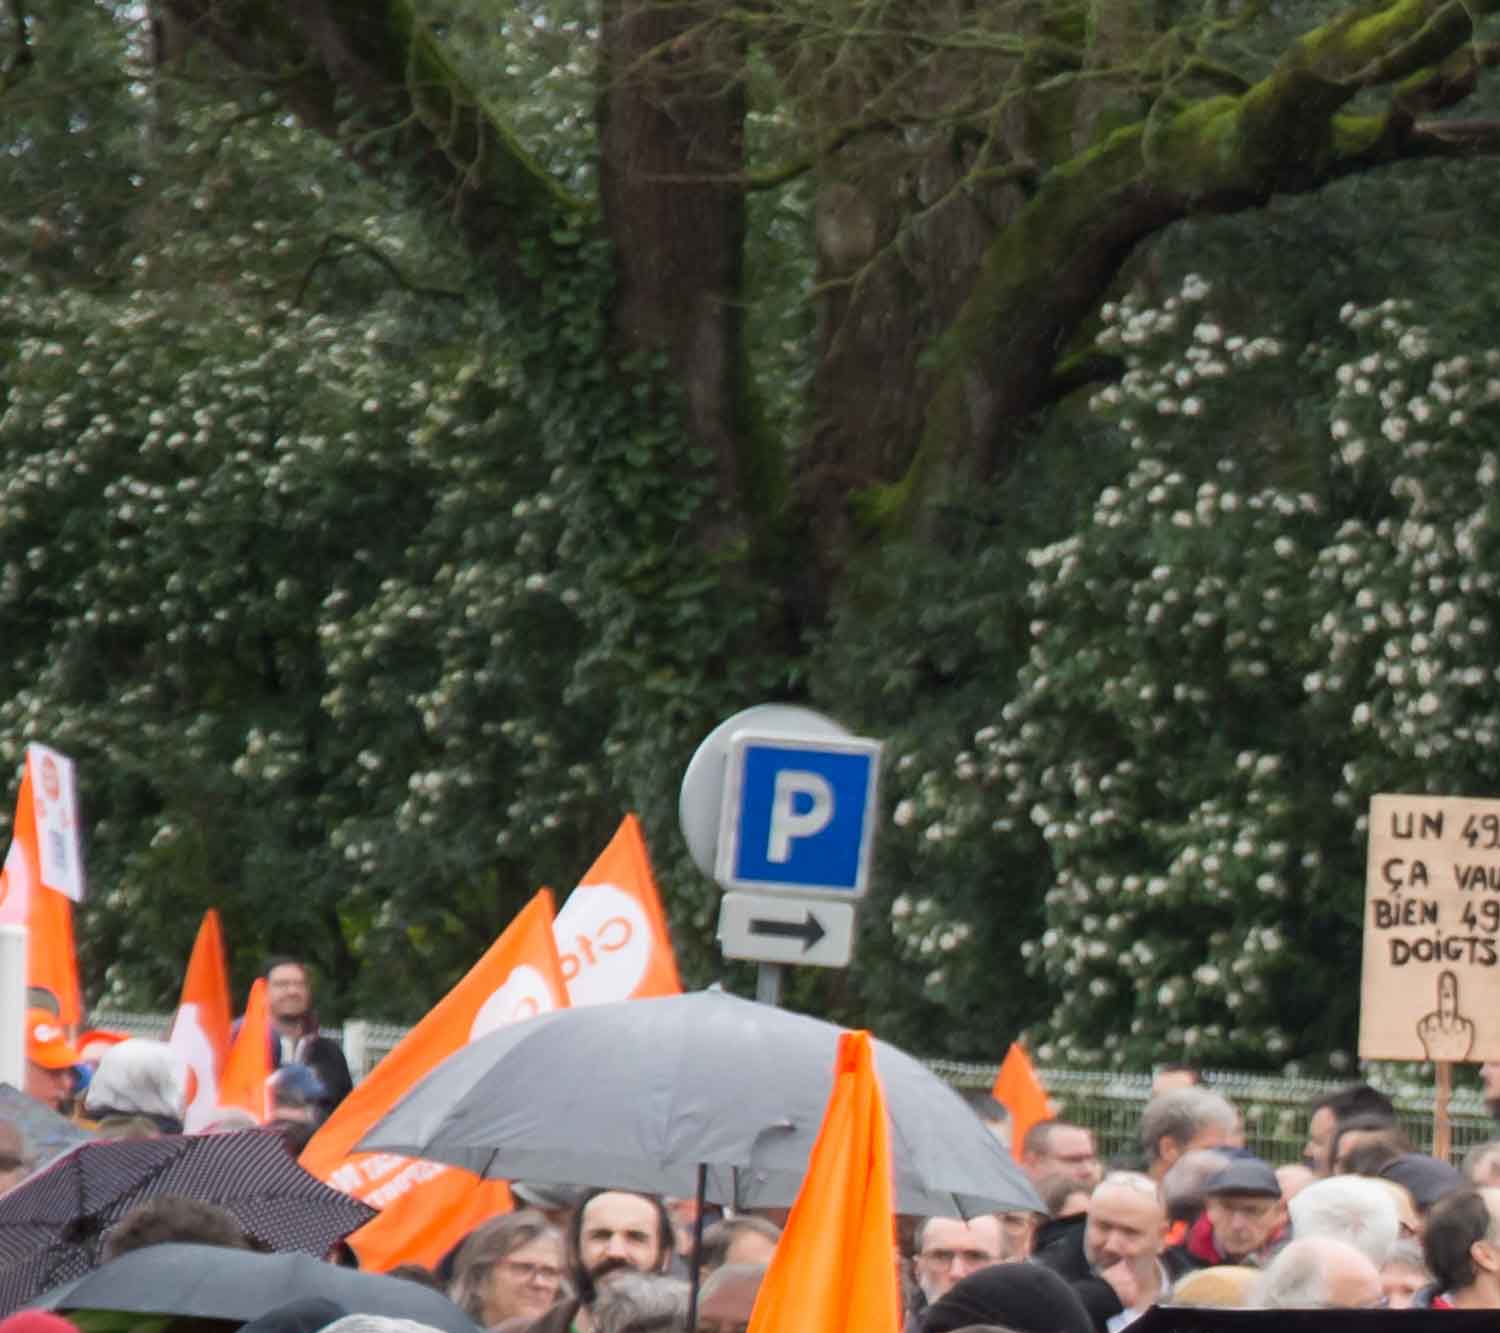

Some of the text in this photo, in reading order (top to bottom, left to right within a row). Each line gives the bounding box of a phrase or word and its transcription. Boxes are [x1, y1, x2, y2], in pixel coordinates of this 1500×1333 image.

[766, 769, 836, 864] P
[1391, 810, 1444, 840] UN
[1381, 858, 1429, 893] ÇA
[1460, 900, 1500, 933] 49
